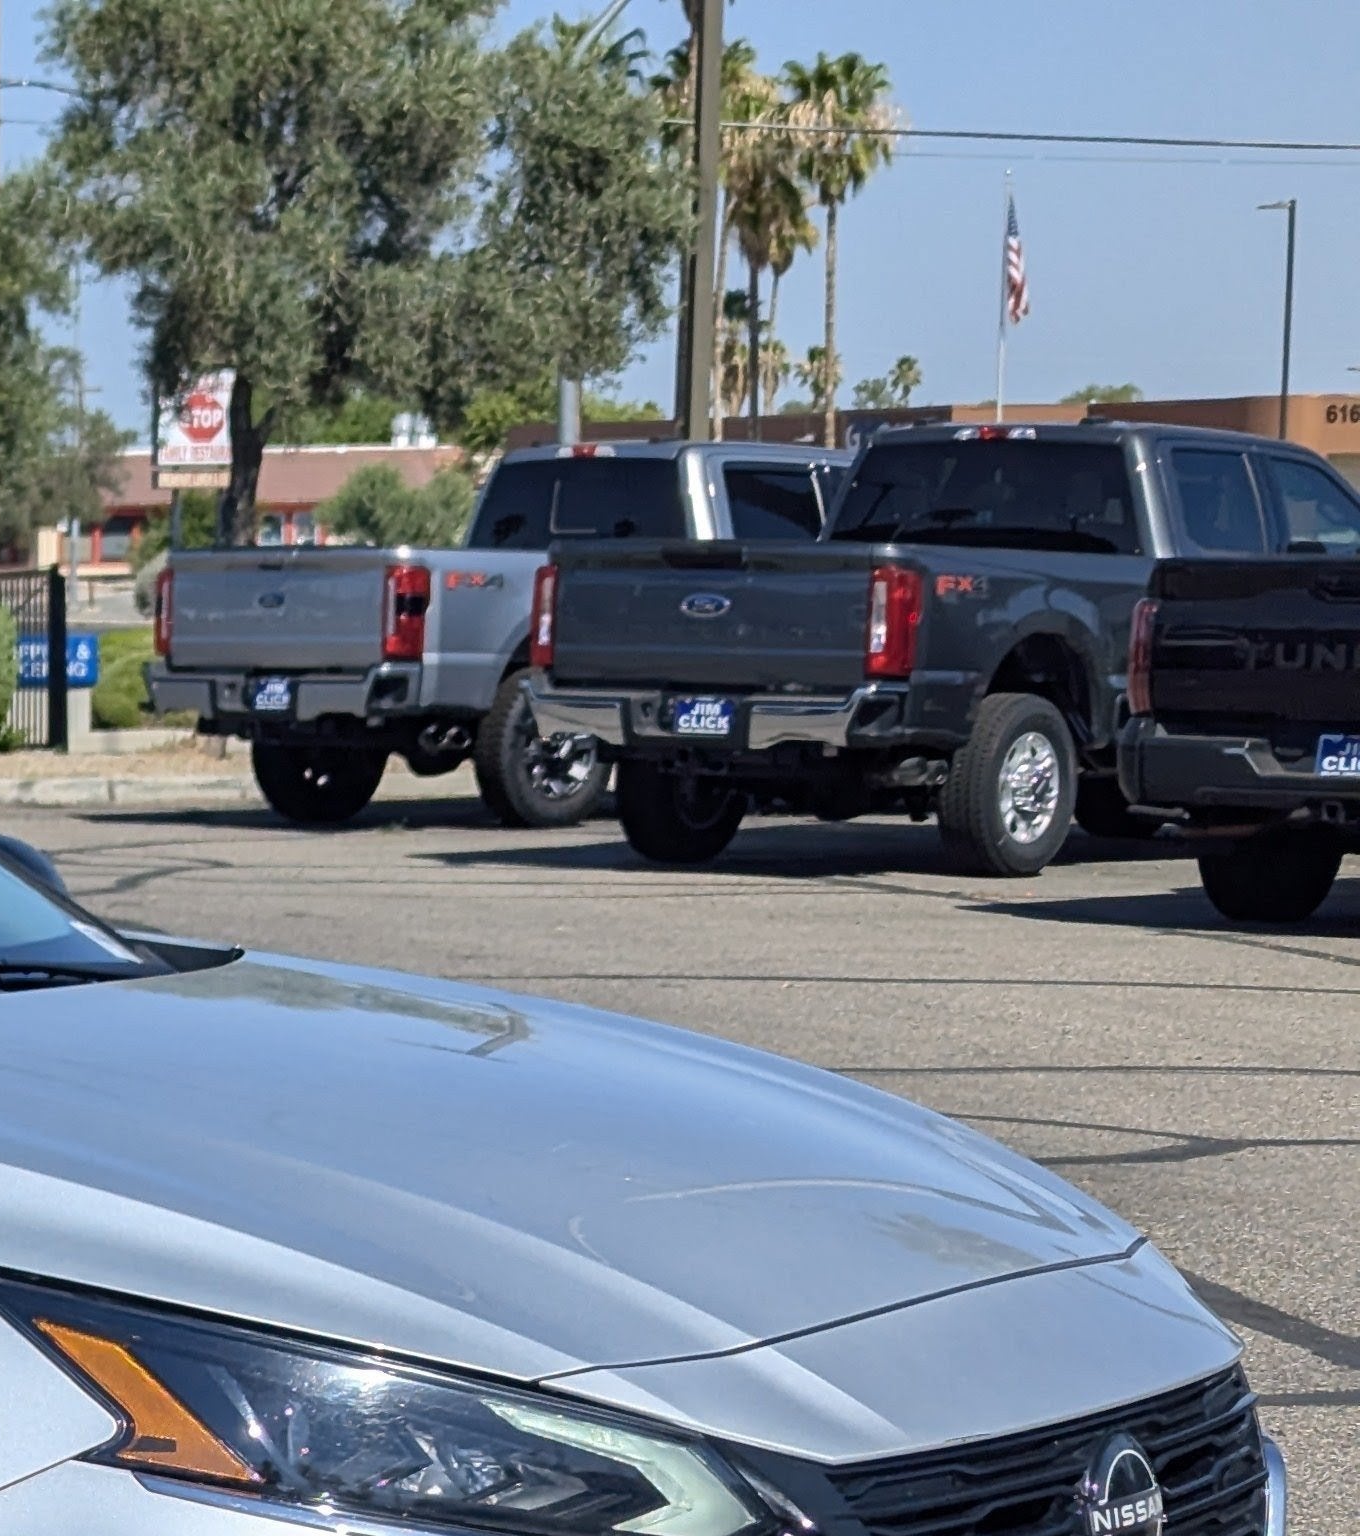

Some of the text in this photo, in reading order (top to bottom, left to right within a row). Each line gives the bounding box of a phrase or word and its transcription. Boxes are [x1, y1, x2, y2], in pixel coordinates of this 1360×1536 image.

[935, 574, 989, 598] FX4
[1248, 641, 1360, 670] TUN
[690, 702, 722, 716] JIM
[678, 714, 730, 729] CLICK
[1337, 742, 1360, 756] JI
[1321, 755, 1360, 771] CLI
[1091, 1490, 1164, 1533] NISSAN
